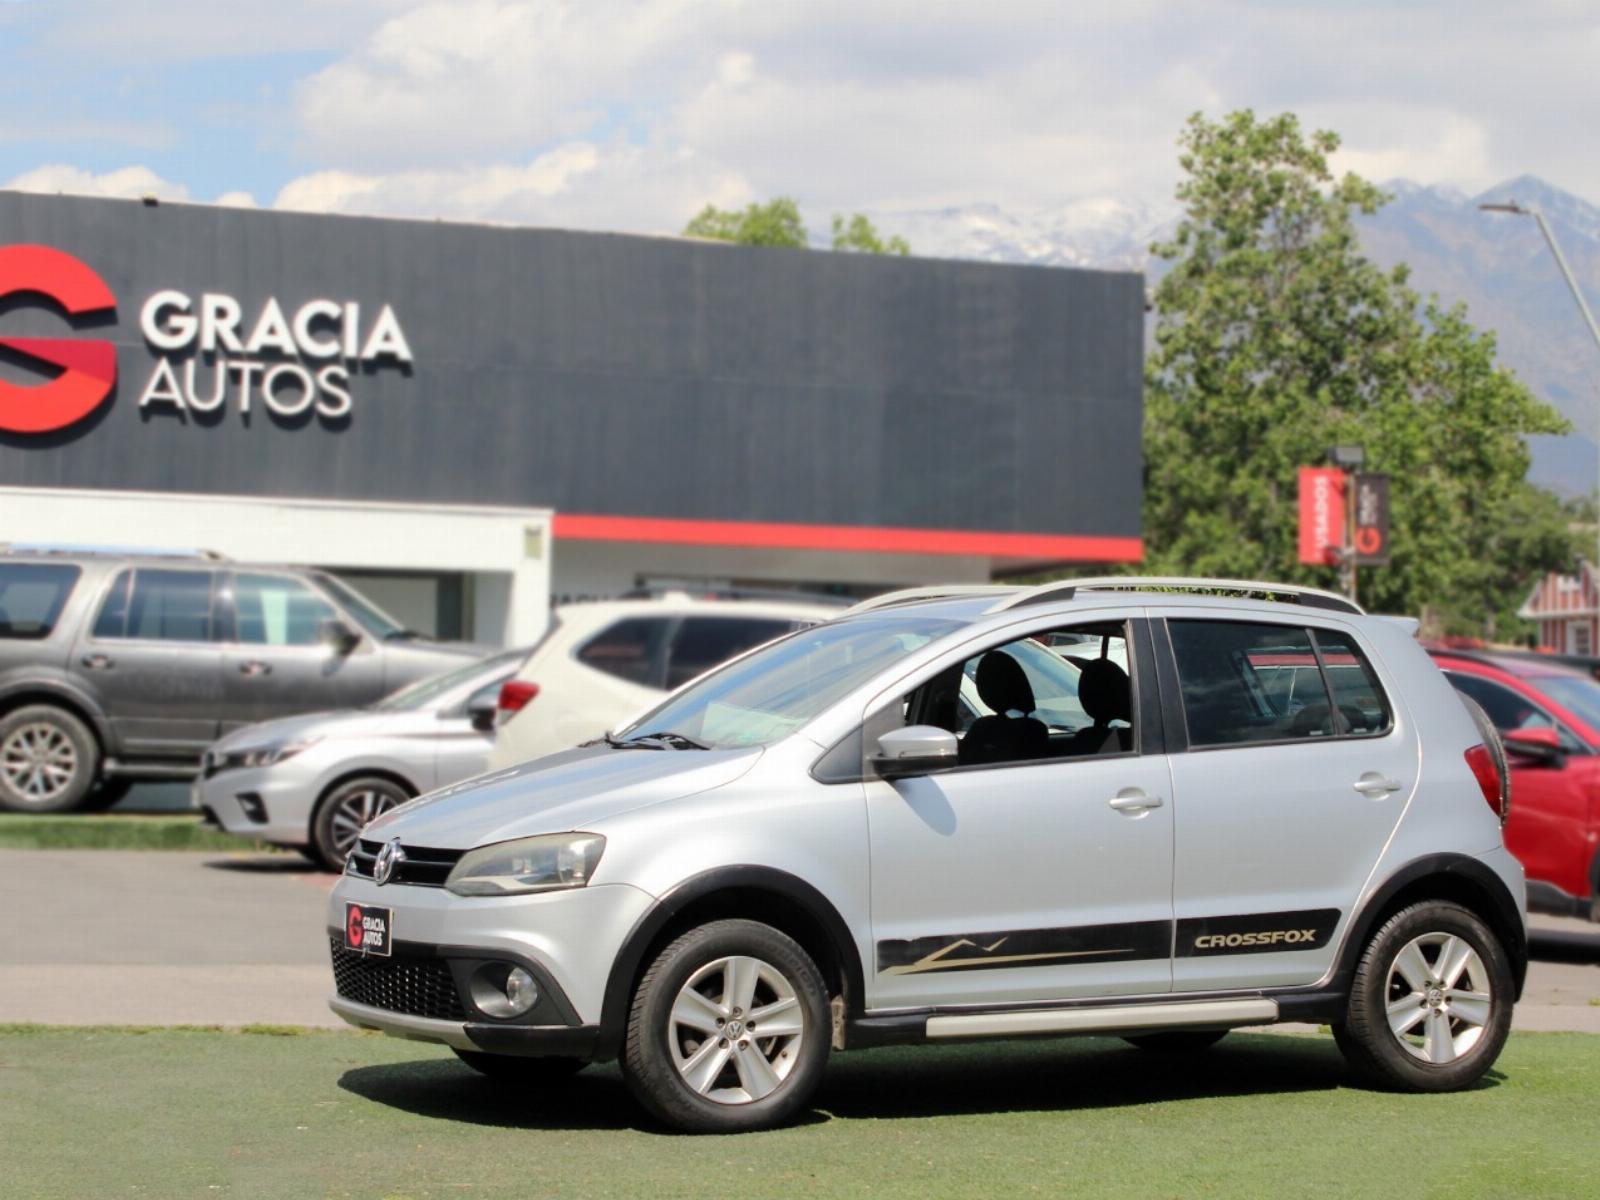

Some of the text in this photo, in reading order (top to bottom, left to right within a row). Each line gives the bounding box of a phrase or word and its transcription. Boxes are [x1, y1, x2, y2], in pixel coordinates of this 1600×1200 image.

[140, 290, 413, 361] GRACIA
[139, 358, 353, 417] AUTOS
[1194, 929, 1317, 949] CROSSFOX
